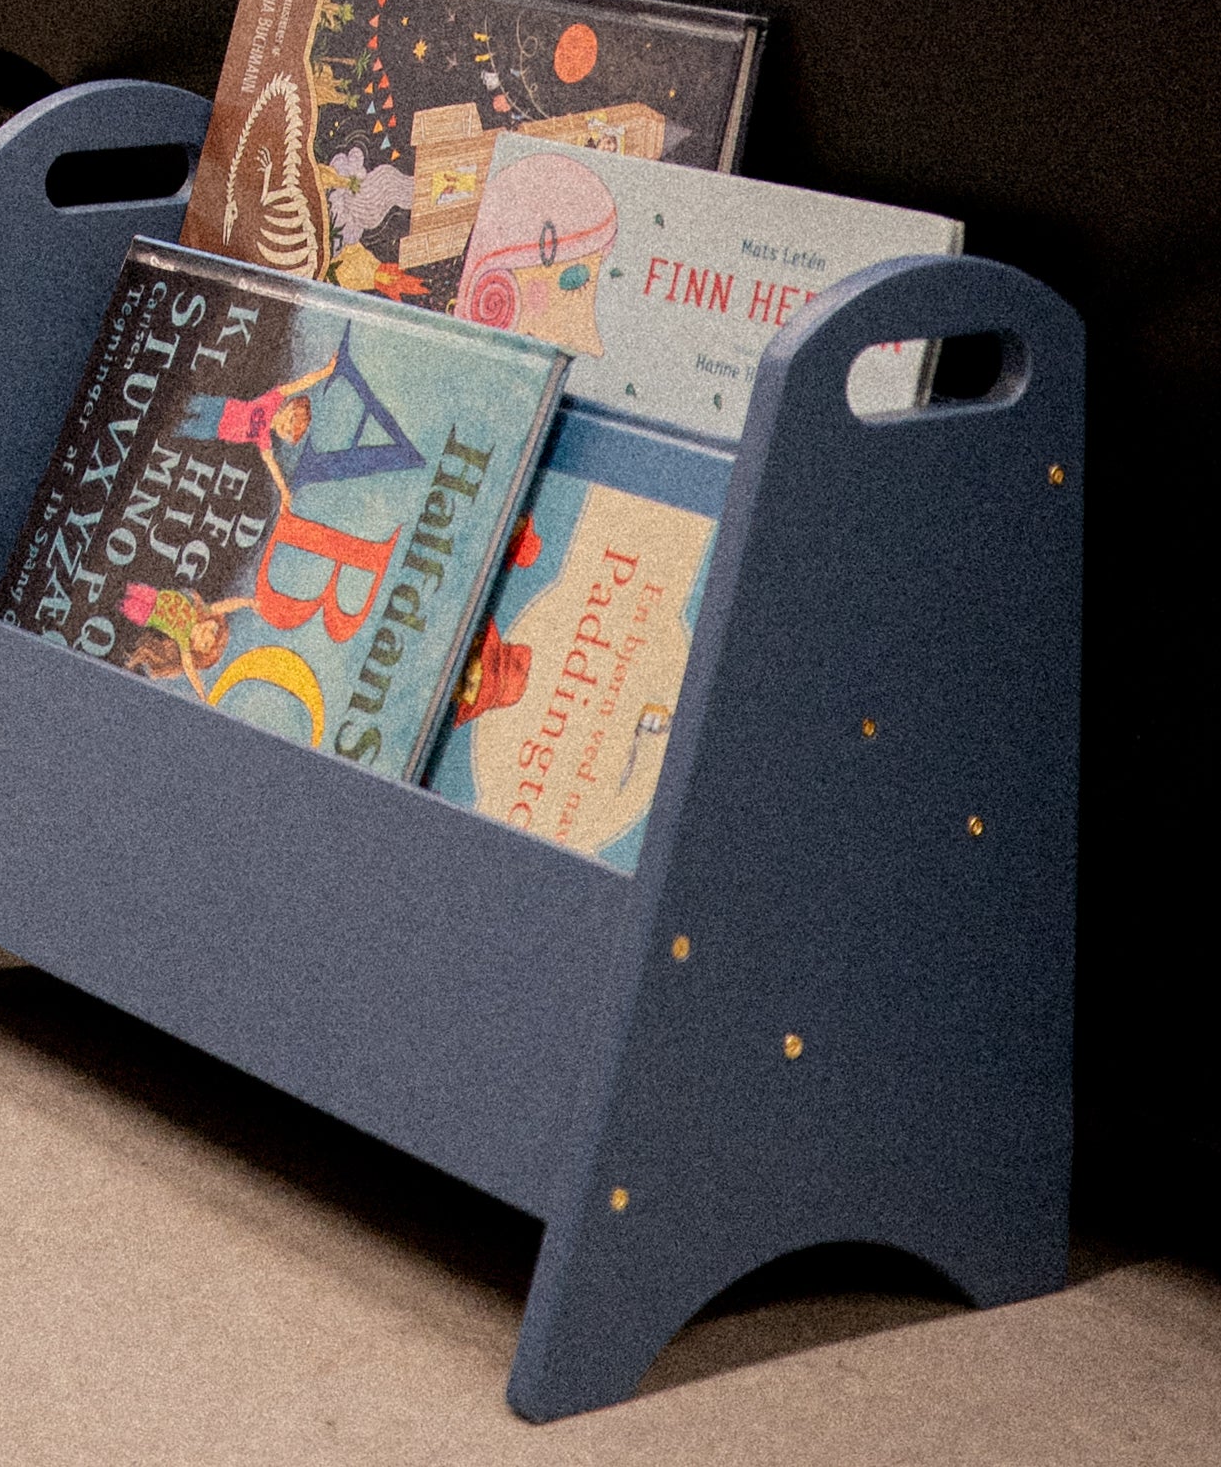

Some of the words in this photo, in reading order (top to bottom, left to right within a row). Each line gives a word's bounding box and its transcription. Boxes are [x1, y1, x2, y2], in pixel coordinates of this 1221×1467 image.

[241, 17, 274, 93] BUCHMANN
[741, 237, 779, 262] Mats
[643, 256, 734, 314] FINN
[123, 280, 168, 371] Carlsen
[78, 284, 146, 434] Tegninger
[696, 353, 741, 379] Hanne
[61, 443, 79, 474] af
[43, 485, 64, 521] Ib
[10, 525, 49, 603] Spang
[333, 423, 496, 766] Halfdans
[633, 581, 665, 624] En
[600, 634, 648, 716] bjørn
[577, 728, 604, 782] ved
